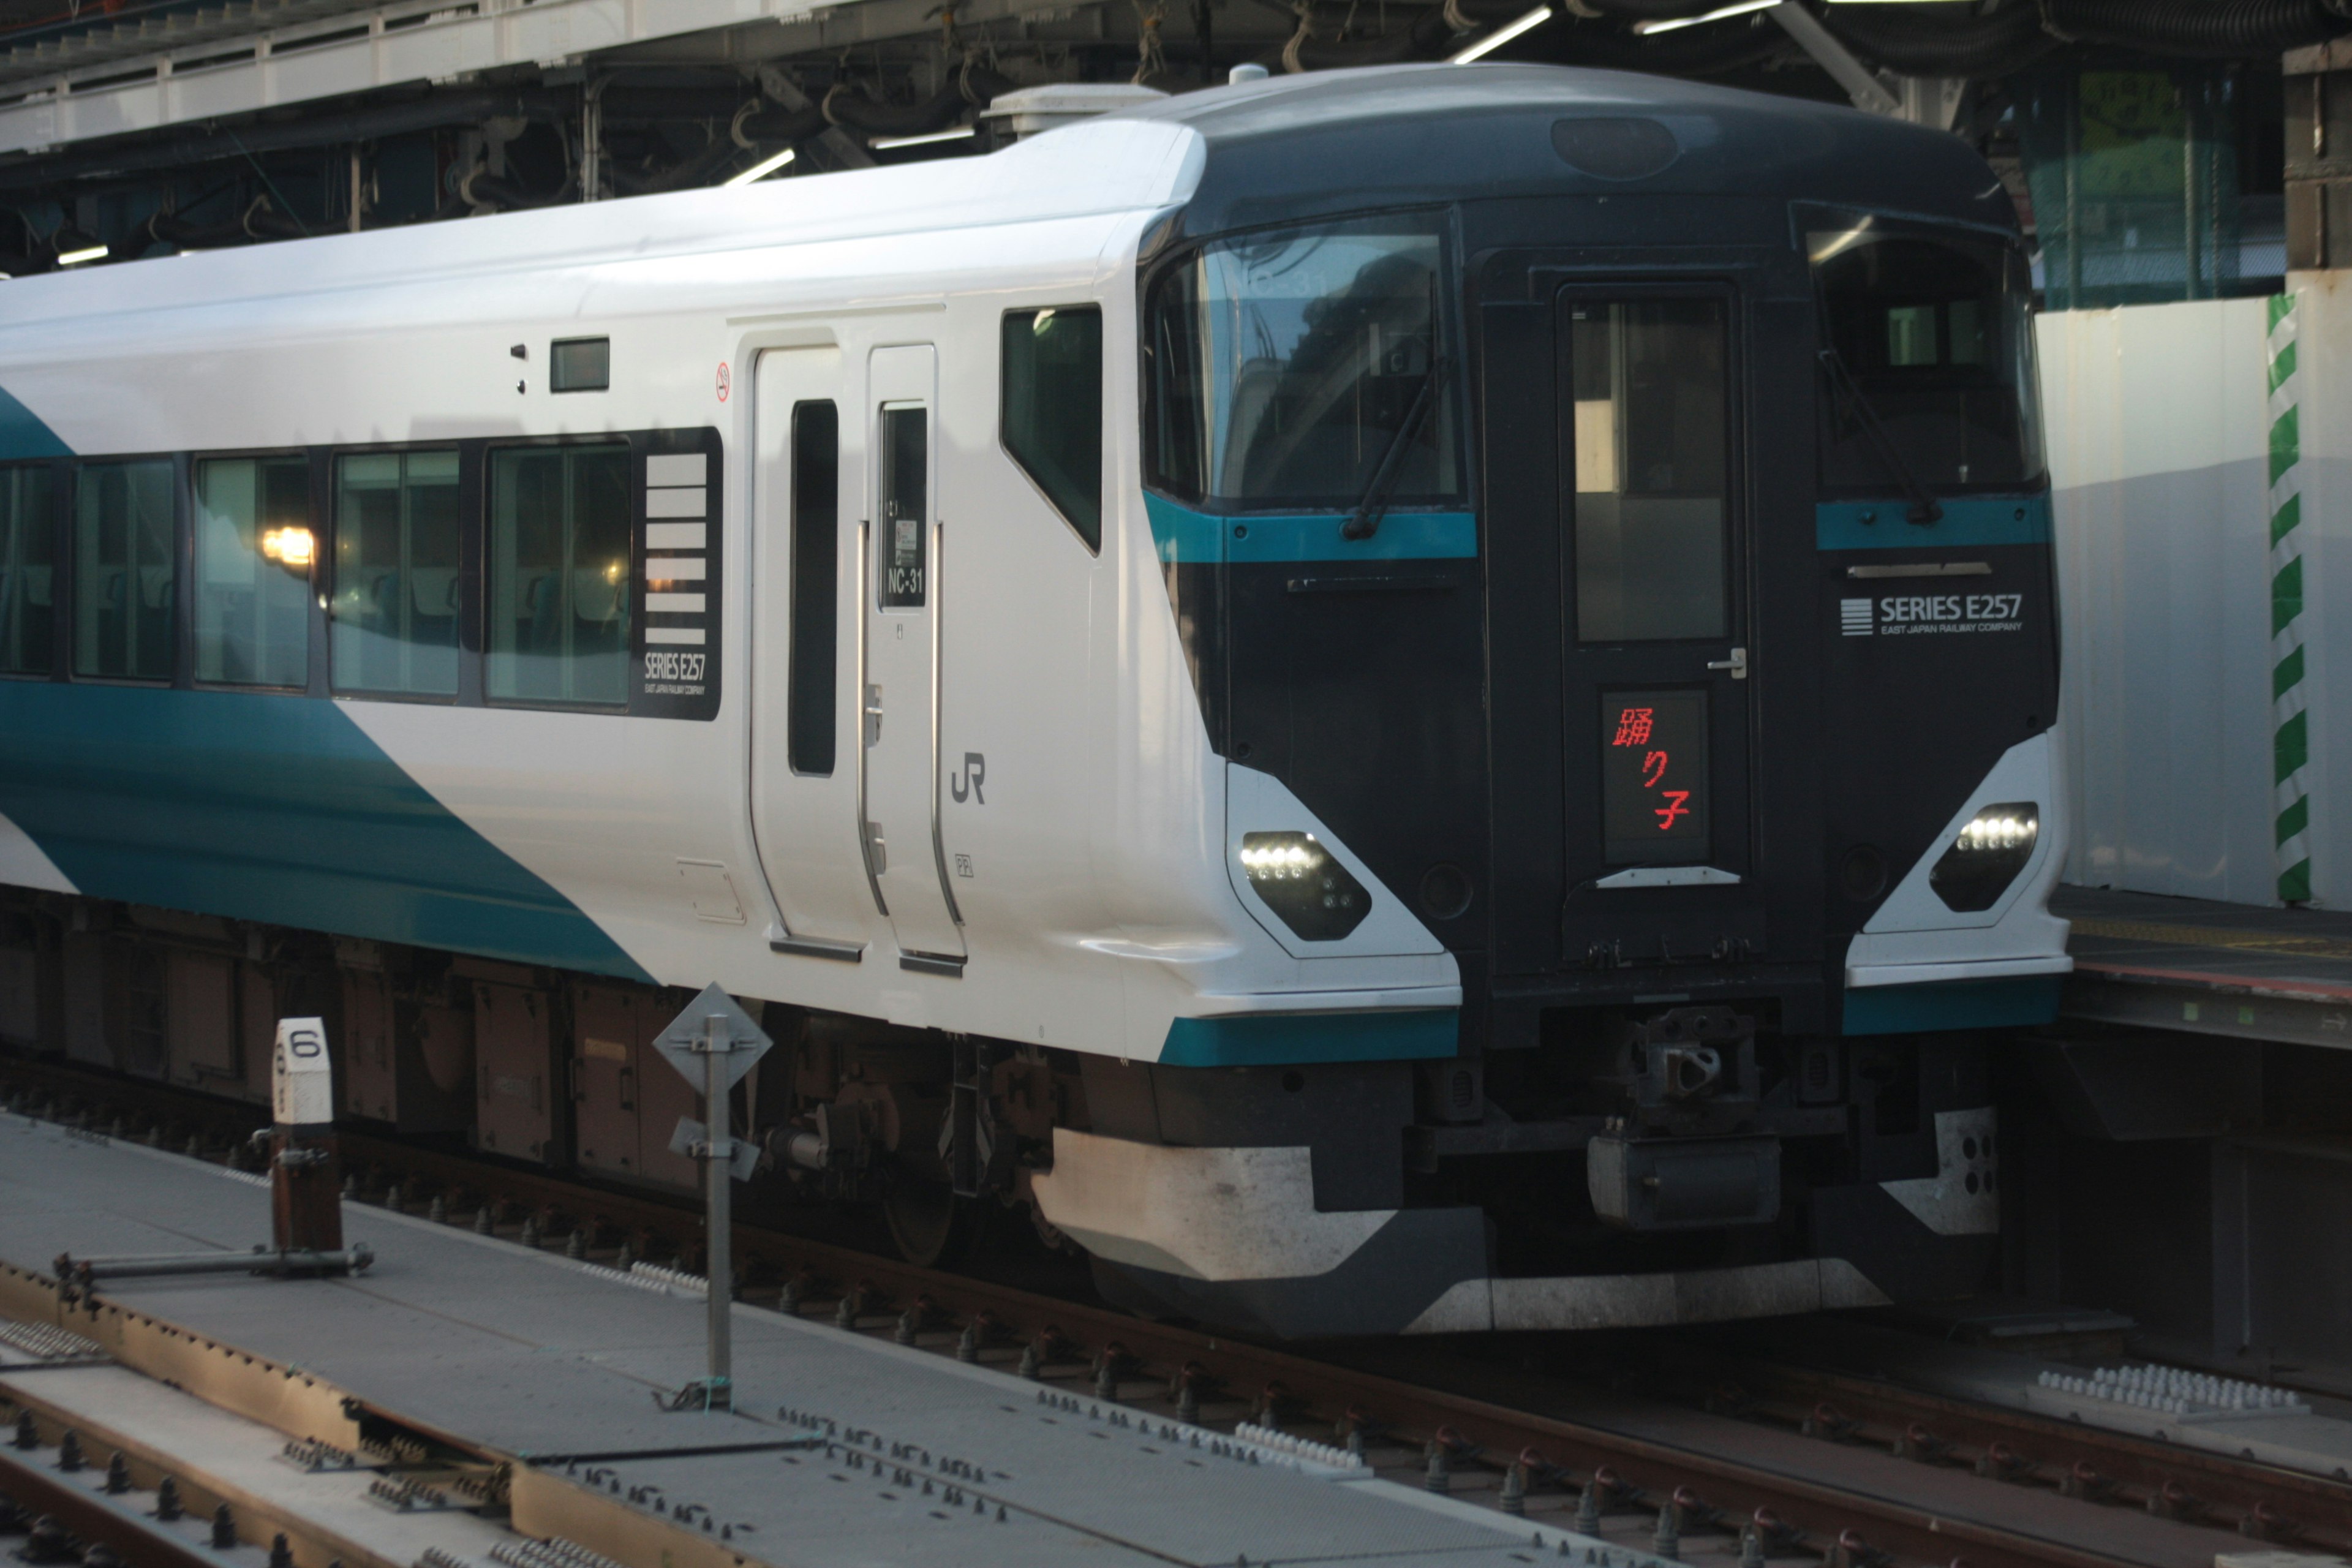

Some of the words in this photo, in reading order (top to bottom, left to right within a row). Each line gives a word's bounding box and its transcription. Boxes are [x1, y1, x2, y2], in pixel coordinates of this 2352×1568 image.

[1880, 595, 1961, 622] SERIES
[1966, 594, 2022, 619] E257
[1881, 625, 1906, 635] EAST
[1907, 624, 1937, 634] JAPAN
[1939, 623, 1977, 633] RAILWAY
[1978, 622, 2022, 631] COMPANY
[645, 652, 679, 680] SERIES
[680, 653, 706, 680] E257
[952, 752, 985, 805] JR
[1612, 708, 1689, 829] 踊り子
[290, 1030, 321, 1058] 6
